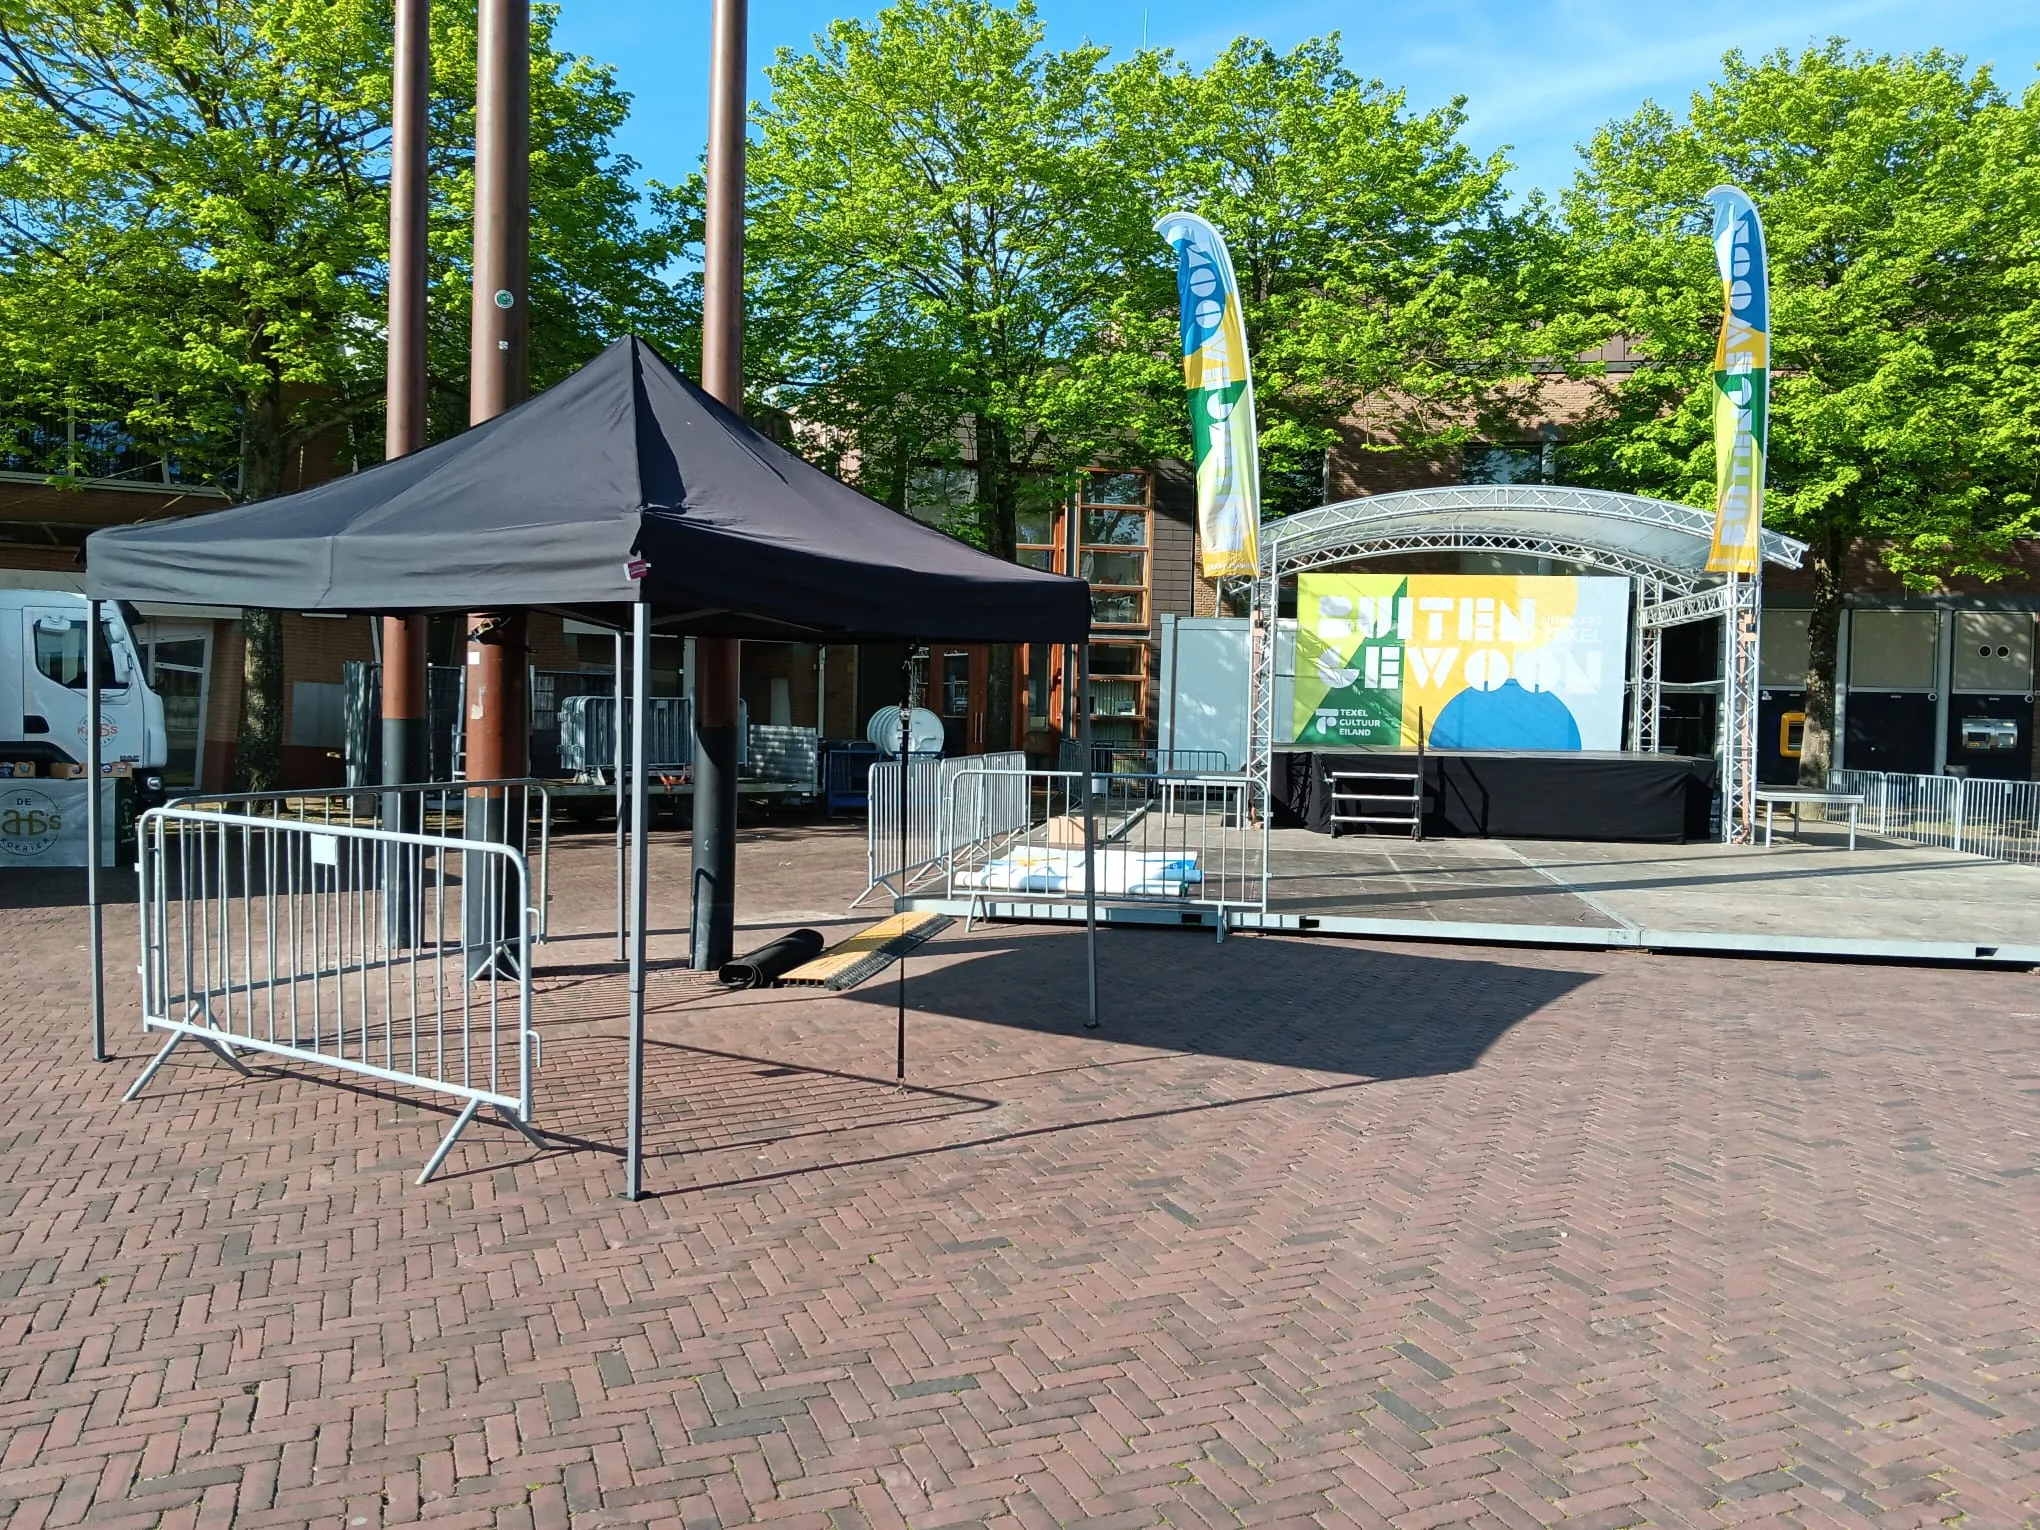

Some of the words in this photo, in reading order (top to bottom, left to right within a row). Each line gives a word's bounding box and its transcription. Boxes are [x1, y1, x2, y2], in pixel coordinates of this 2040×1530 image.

[1318, 596, 1536, 642] BUITEN
[1317, 646, 1602, 694] GEWOON
[1340, 708, 1368, 717] TEXEL
[1339, 718, 1381, 728] CULTUUR
[1339, 728, 1371, 737] EILAND
[16, 797, 33, 806] DE
